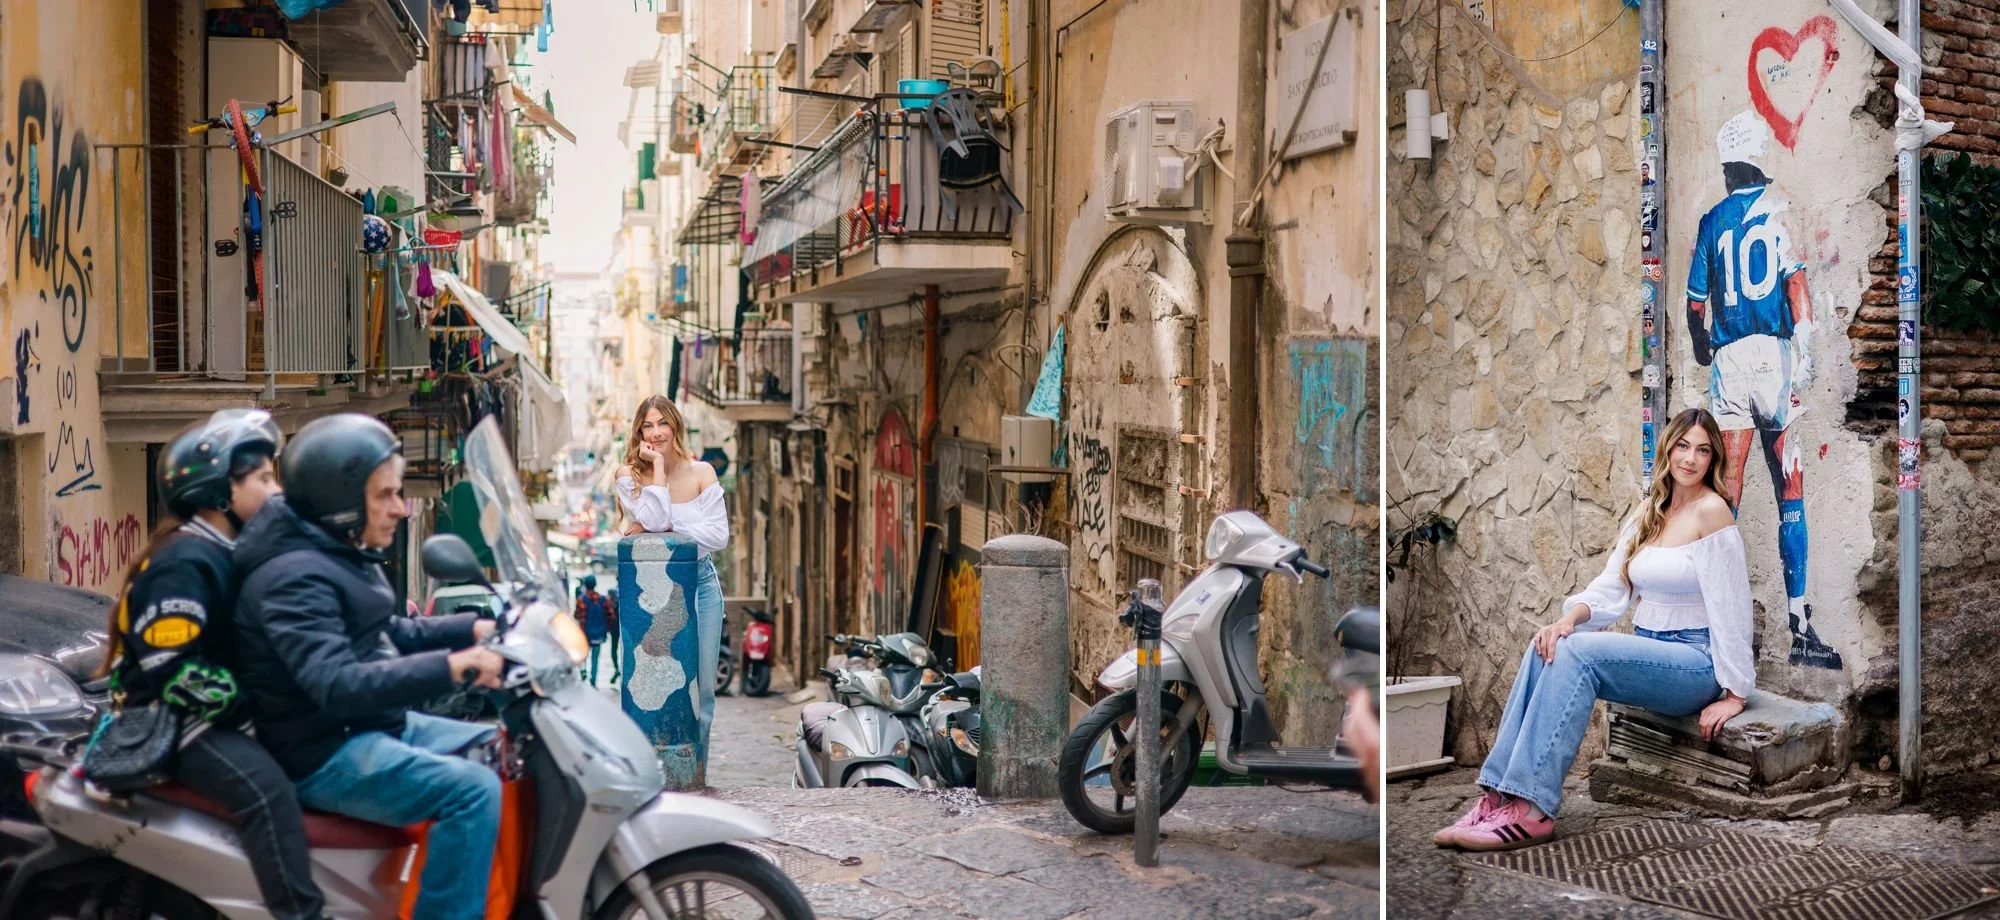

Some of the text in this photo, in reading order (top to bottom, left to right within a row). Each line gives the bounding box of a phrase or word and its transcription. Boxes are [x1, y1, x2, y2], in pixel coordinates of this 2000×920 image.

[1304, 39, 1322, 57] VICO
[1717, 224, 1778, 307] 10
[57, 516, 111, 587] SIAMO
